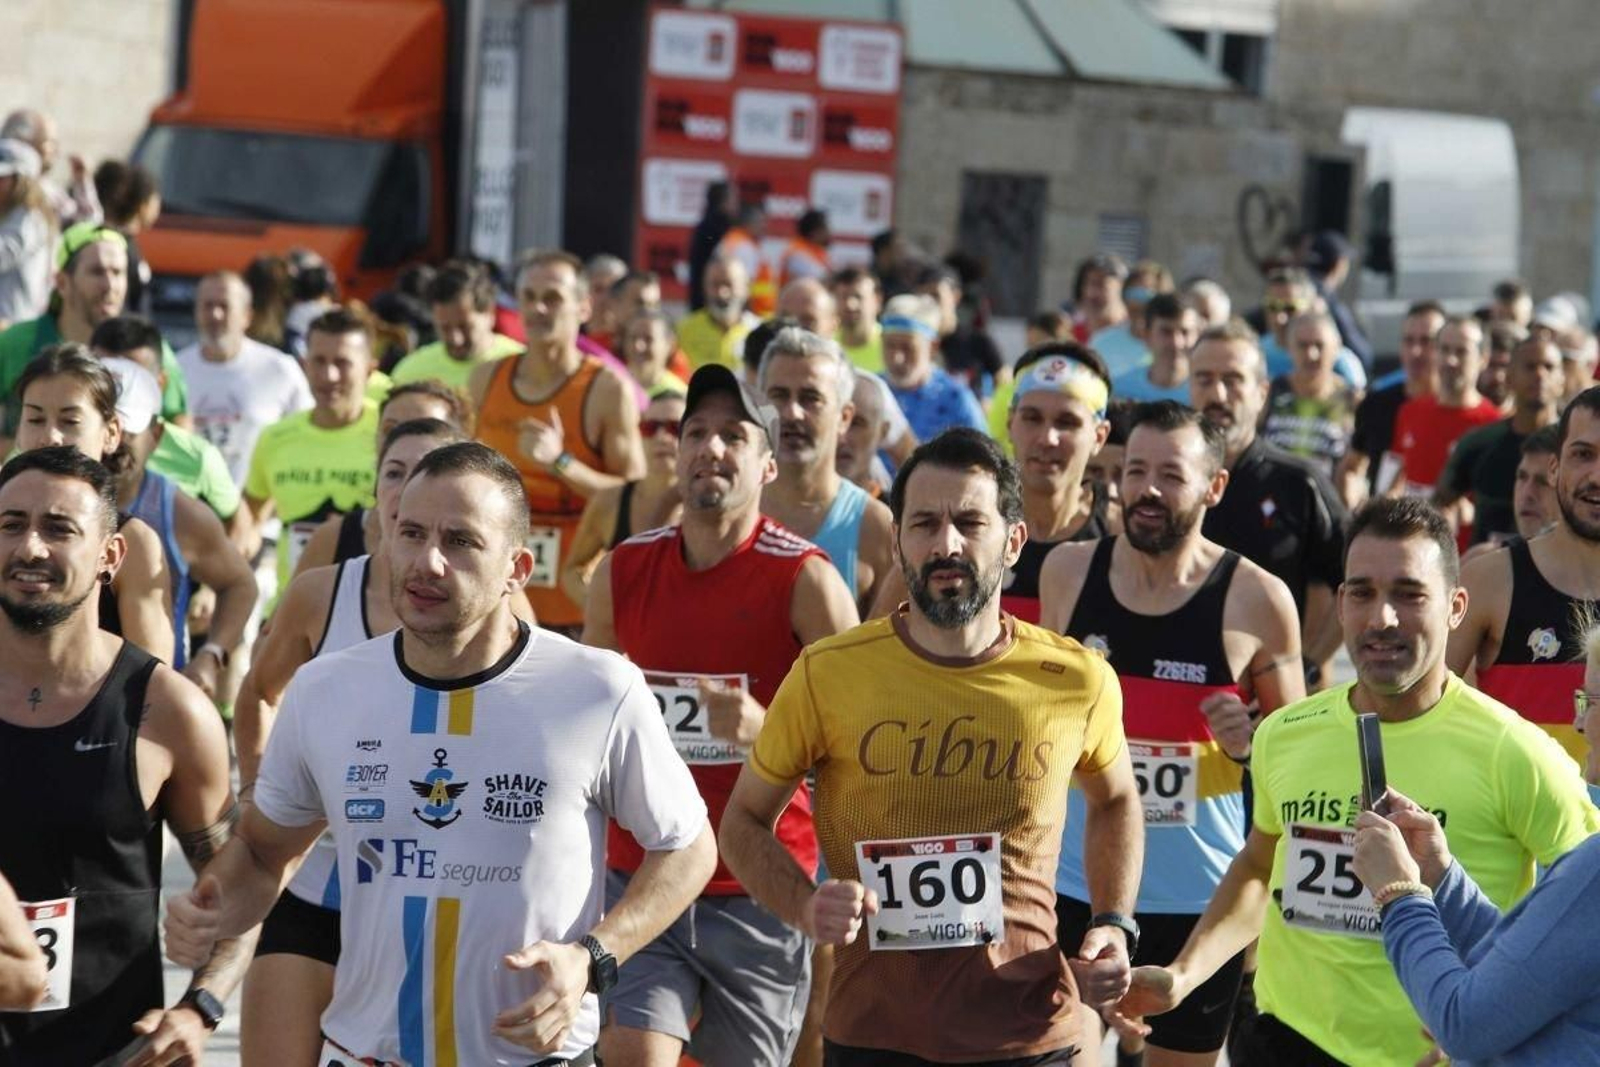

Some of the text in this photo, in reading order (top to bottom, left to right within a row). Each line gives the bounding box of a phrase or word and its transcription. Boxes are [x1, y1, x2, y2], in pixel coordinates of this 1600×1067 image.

[1153, 659, 1207, 684] 226ERS
[484, 774, 547, 797] SHAVE
[483, 797, 545, 818] SAILOR
[1281, 790, 1342, 824] máis
[911, 843, 944, 855] VIGO
[441, 863, 522, 887] seguros
[877, 857, 986, 908] 160
[1297, 849, 1364, 899] 25
[928, 922, 966, 941] VIGO
